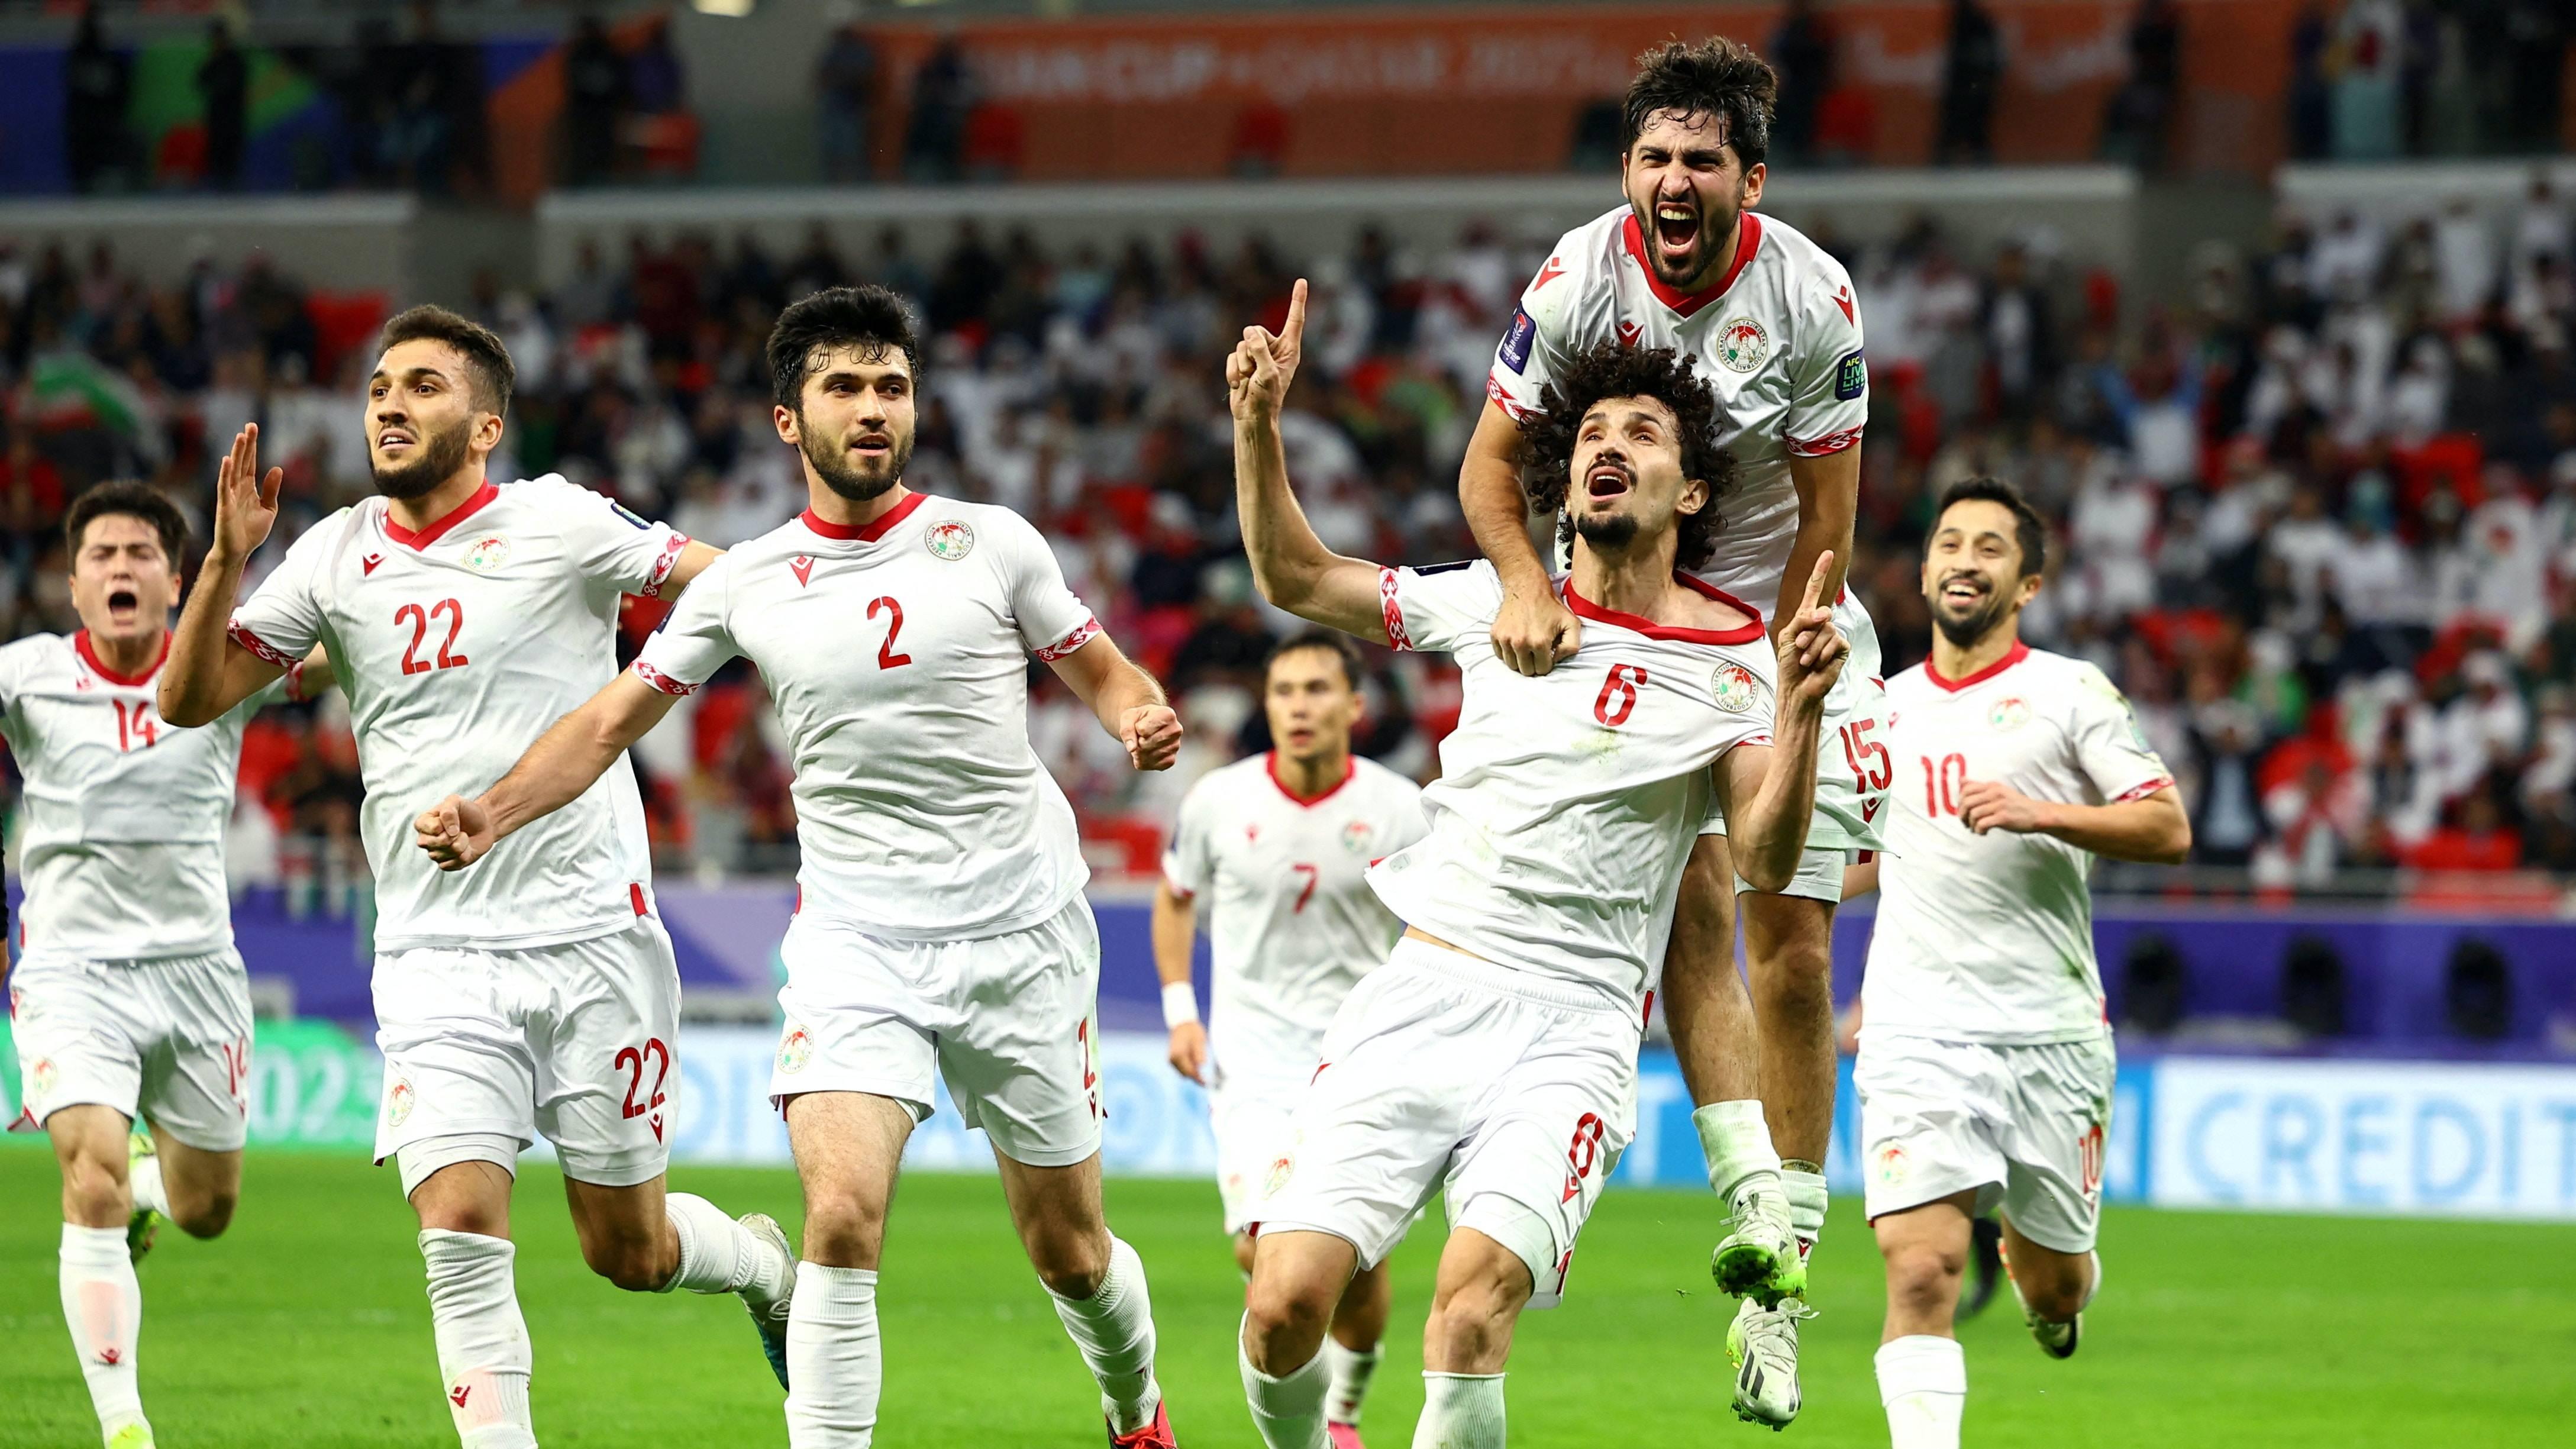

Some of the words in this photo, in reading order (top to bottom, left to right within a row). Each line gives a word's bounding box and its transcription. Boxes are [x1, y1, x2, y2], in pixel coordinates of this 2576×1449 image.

[1735, 352, 1765, 370] FOOTBALL
[1845, 356, 1860, 367] AFC
[394, 598, 469, 676] 22
[867, 596, 912, 670] 2
[112, 699, 160, 753] 14
[1593, 663, 1648, 727] 6
[1839, 718, 1893, 794] 15
[1920, 753, 1965, 818] 10
[1293, 863, 1318, 914] 7
[615, 1037, 669, 1119] 22
[1568, 1112, 1603, 1178] 6
[2078, 1125, 2103, 1195] 10
[2184, 1086, 2576, 1205] CREDIT
